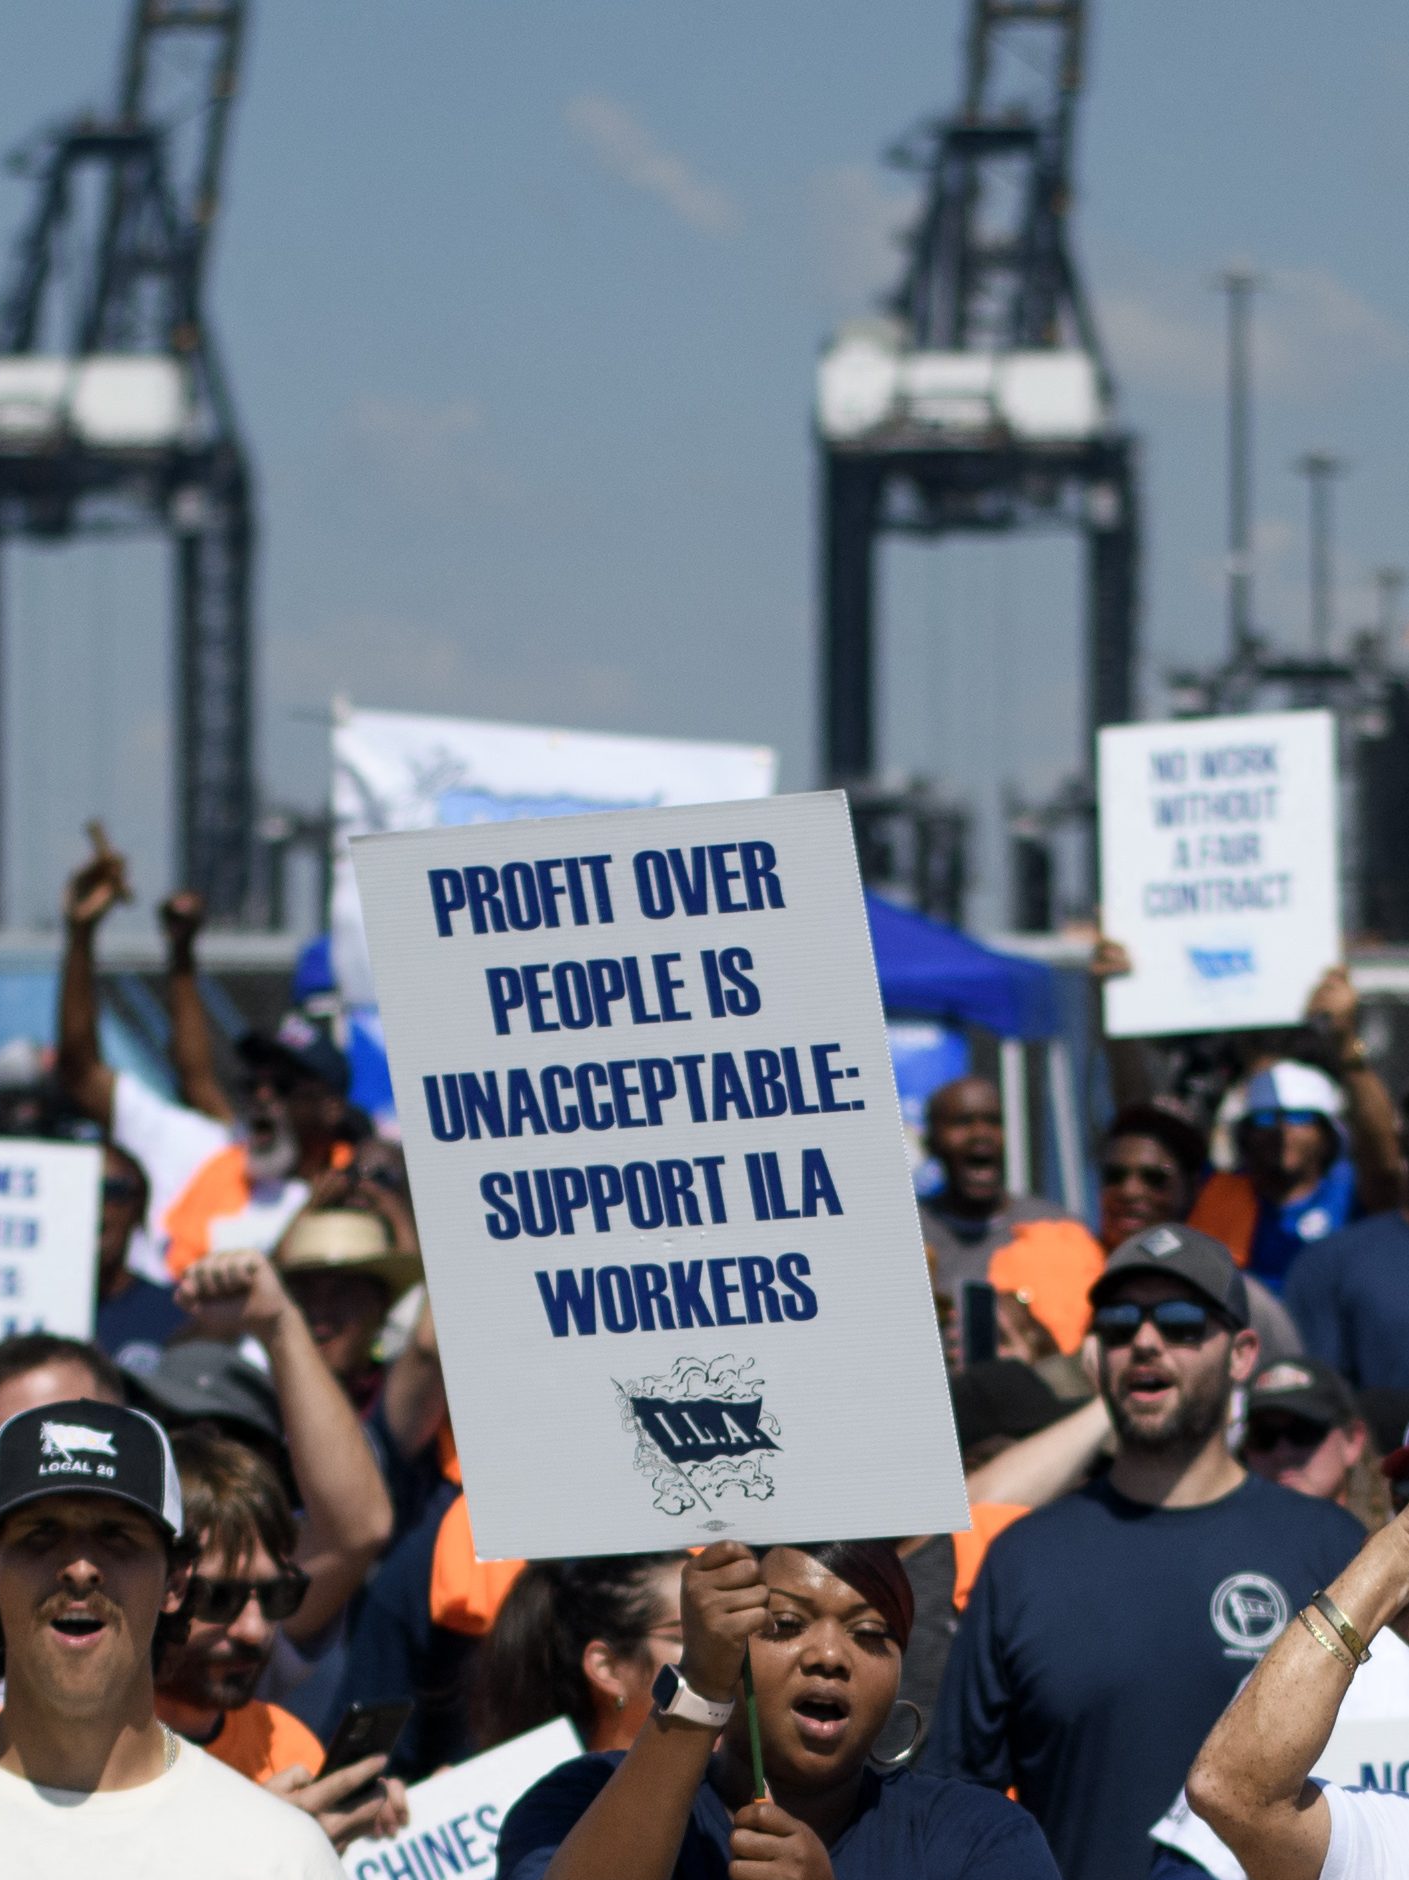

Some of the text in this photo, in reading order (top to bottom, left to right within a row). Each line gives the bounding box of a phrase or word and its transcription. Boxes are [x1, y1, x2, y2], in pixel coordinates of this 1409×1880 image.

[1151, 743, 1277, 781] NO WORK
[1152, 786, 1278, 828] WITHOUT
[1174, 833, 1260, 869] A FAIR
[427, 841, 786, 938] PROFIT OVER
[1144, 873, 1291, 917] CONTRACT
[486, 946, 762, 1035] PEOPLE IS
[422, 1042, 866, 1143] UNACCEPTABLE:
[478, 1147, 843, 1241] SUPPORT ILA
[534, 1252, 818, 1338] WORKERS
[654, 1411, 761, 1446] I.L.A.
[38, 1461, 92, 1476] LOCAL
